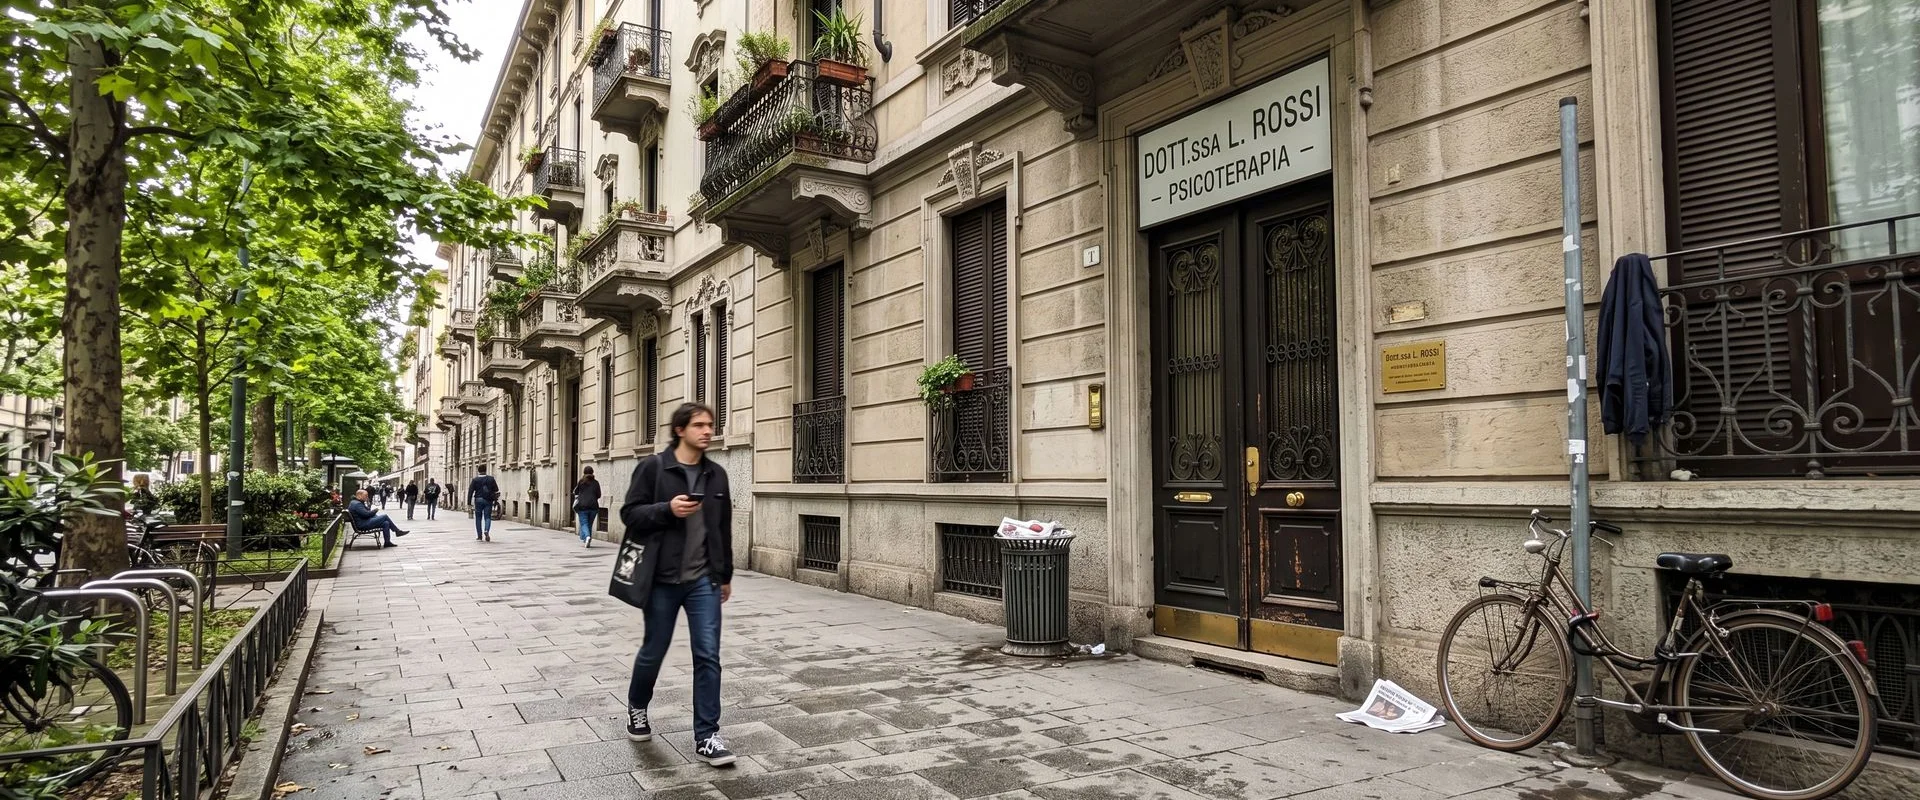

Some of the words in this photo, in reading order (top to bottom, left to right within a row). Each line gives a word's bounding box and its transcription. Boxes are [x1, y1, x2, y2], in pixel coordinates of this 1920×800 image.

[1228, 120, 1245, 149] L.
[1253, 85, 1321, 140] ROSSI
[1169, 145, 1290, 205] PSICOTERAPIA
[1088, 250, 1095, 263] T
[1420, 348, 1440, 358] ROSSI
